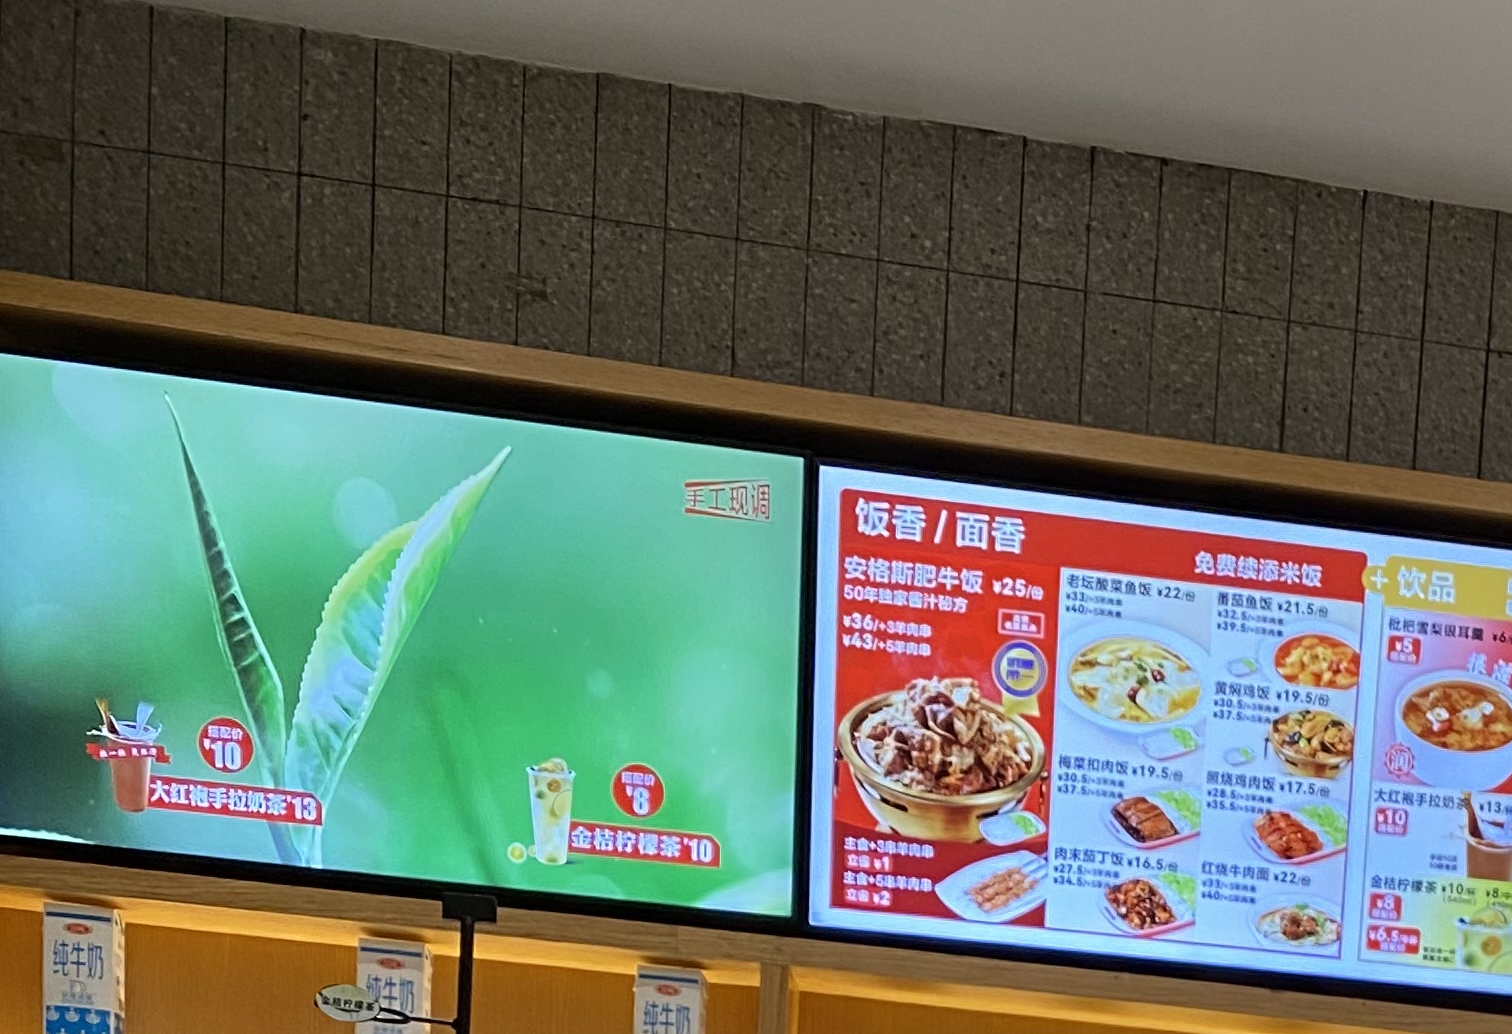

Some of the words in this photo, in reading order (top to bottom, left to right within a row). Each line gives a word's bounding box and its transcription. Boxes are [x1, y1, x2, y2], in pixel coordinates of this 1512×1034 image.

[683, 480, 772, 523] 手工现调
[855, 497, 926, 543] 饭香
[955, 511, 1025, 554] 面香
[844, 555, 983, 594] 安格斯肥牛饭
[1195, 551, 1323, 588] 免费续添米饭
[1066, 574, 1152, 597] 老坛酸菜鱼饭
[1397, 566, 1456, 604] 饮品
[1217, 591, 1274, 612] 番茄鱼饭
[1388, 617, 1484, 641] 枇杷雪梨银耳羹
[1214, 681, 1270, 701] 黄焖鸡饭
[1058, 755, 1128, 776] 梅菜扣肉饭
[1206, 771, 1276, 792] 照烧鸡肉饭
[1054, 847, 1124, 866] 肉末茄丁饭
[1201, 860, 1269, 881] 红烧牛肉面
[1371, 875, 1437, 894] 金桔柠檬茶
[52, 939, 105, 981] 纯牛奶
[366, 973, 415, 1015] 纯牛奶
